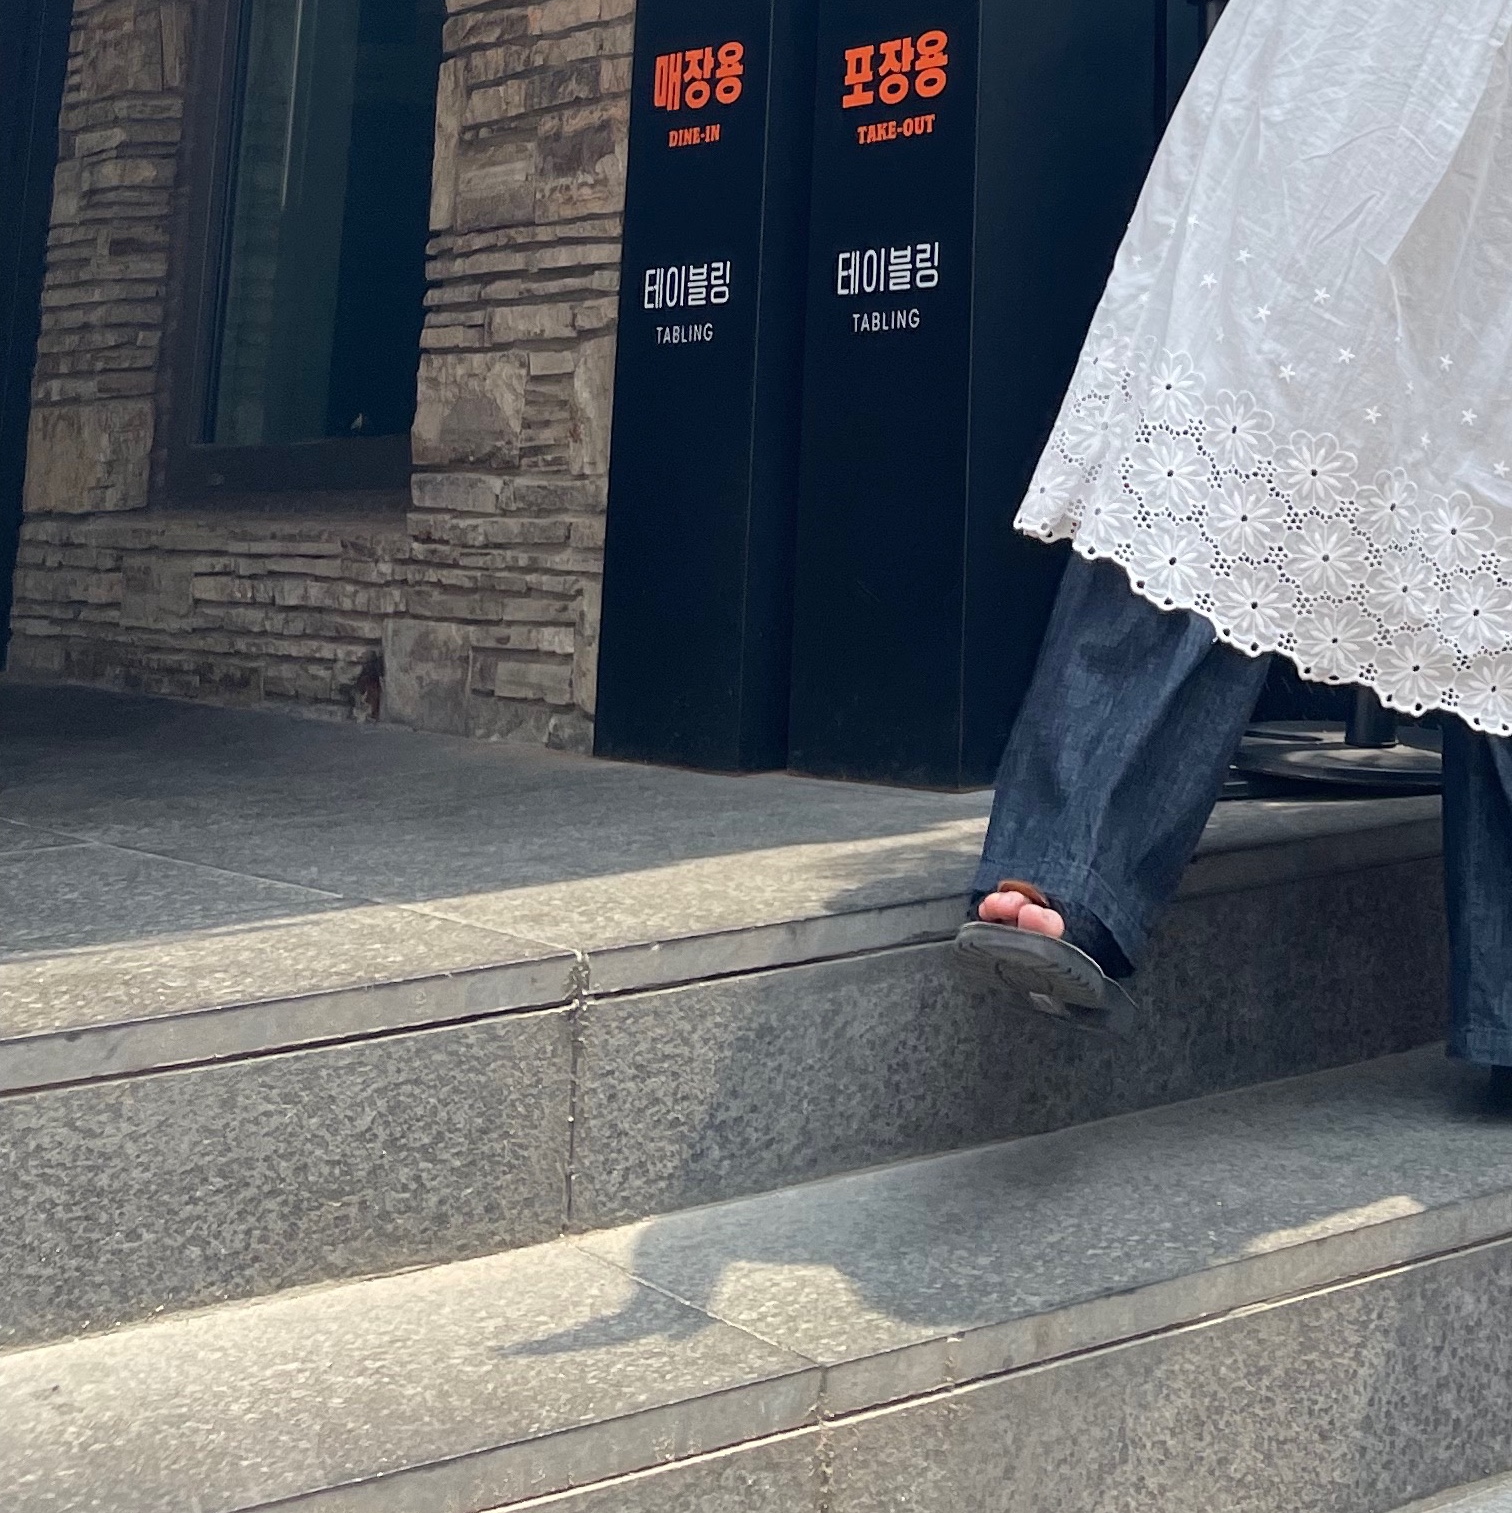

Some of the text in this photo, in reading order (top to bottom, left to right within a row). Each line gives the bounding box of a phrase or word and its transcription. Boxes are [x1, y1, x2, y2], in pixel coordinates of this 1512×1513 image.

[653, 41, 745, 112] 매장용
[842, 29, 949, 109] 포장용
[668, 124, 720, 148] DINE-IN
[856, 113, 936, 145] TAKE-OUT
[644, 261, 731, 309] 테이블링
[837, 241, 939, 296] 테이블링
[656, 322, 713, 345] TABLING
[852, 308, 921, 333] TABLING
